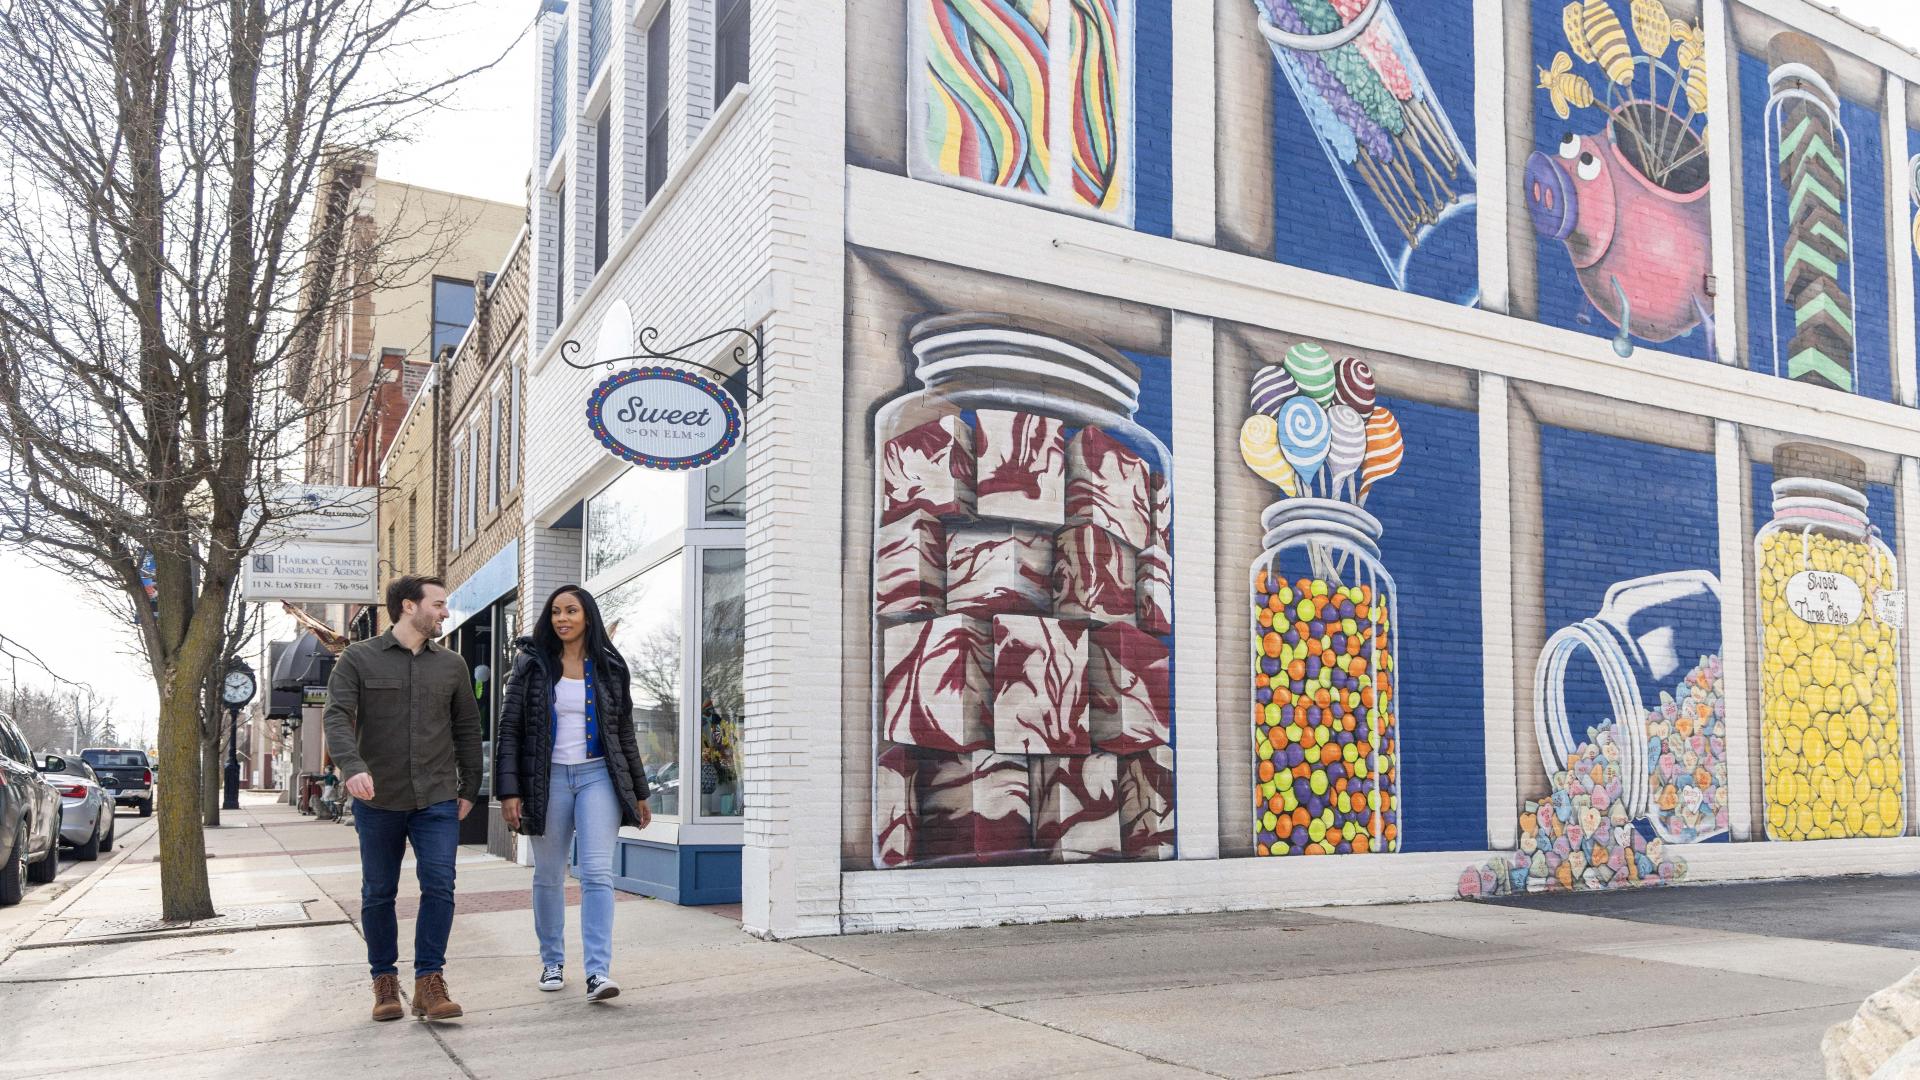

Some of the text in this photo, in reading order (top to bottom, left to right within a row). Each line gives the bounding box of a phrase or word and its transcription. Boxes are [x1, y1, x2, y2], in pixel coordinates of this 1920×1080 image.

[617, 396, 711, 426] Sweet
[639, 428, 692, 440] ON ELM
[278, 555, 368, 567] HARBOR COUNTRY
[278, 564, 368, 577] INSURANCE AGENCY
[276, 581, 292, 589] ELM
[1807, 572, 1838, 591] Sweet
[1795, 597, 1849, 625] Three Oaks
